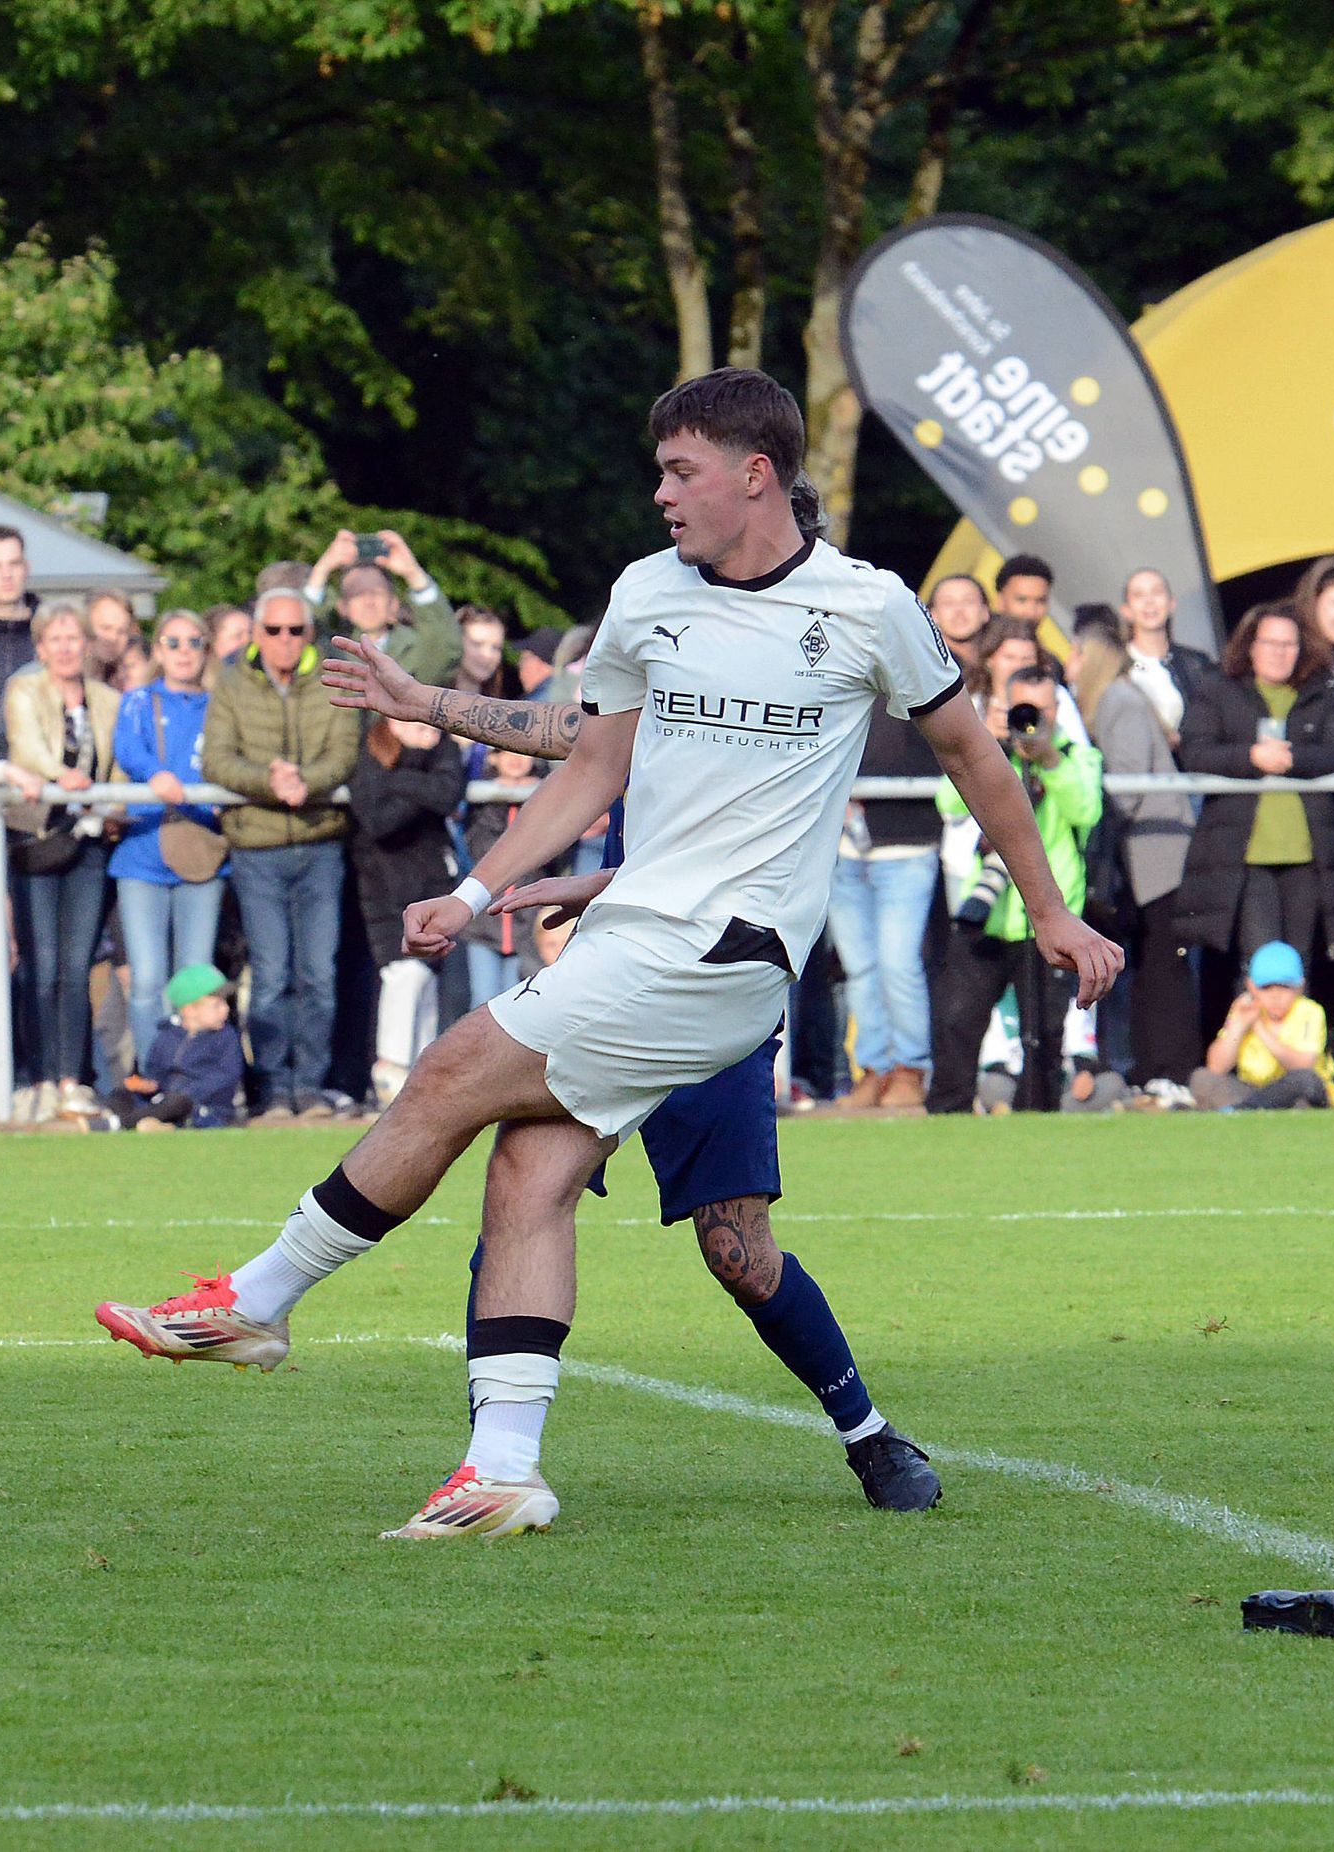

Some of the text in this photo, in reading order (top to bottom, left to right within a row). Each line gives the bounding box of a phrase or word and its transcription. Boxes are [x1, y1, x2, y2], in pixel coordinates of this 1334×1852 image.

[653, 689, 823, 728] REUTER
[656, 725, 820, 751] DER LEUCHTEN
[820, 1367, 854, 1395] JAKO
